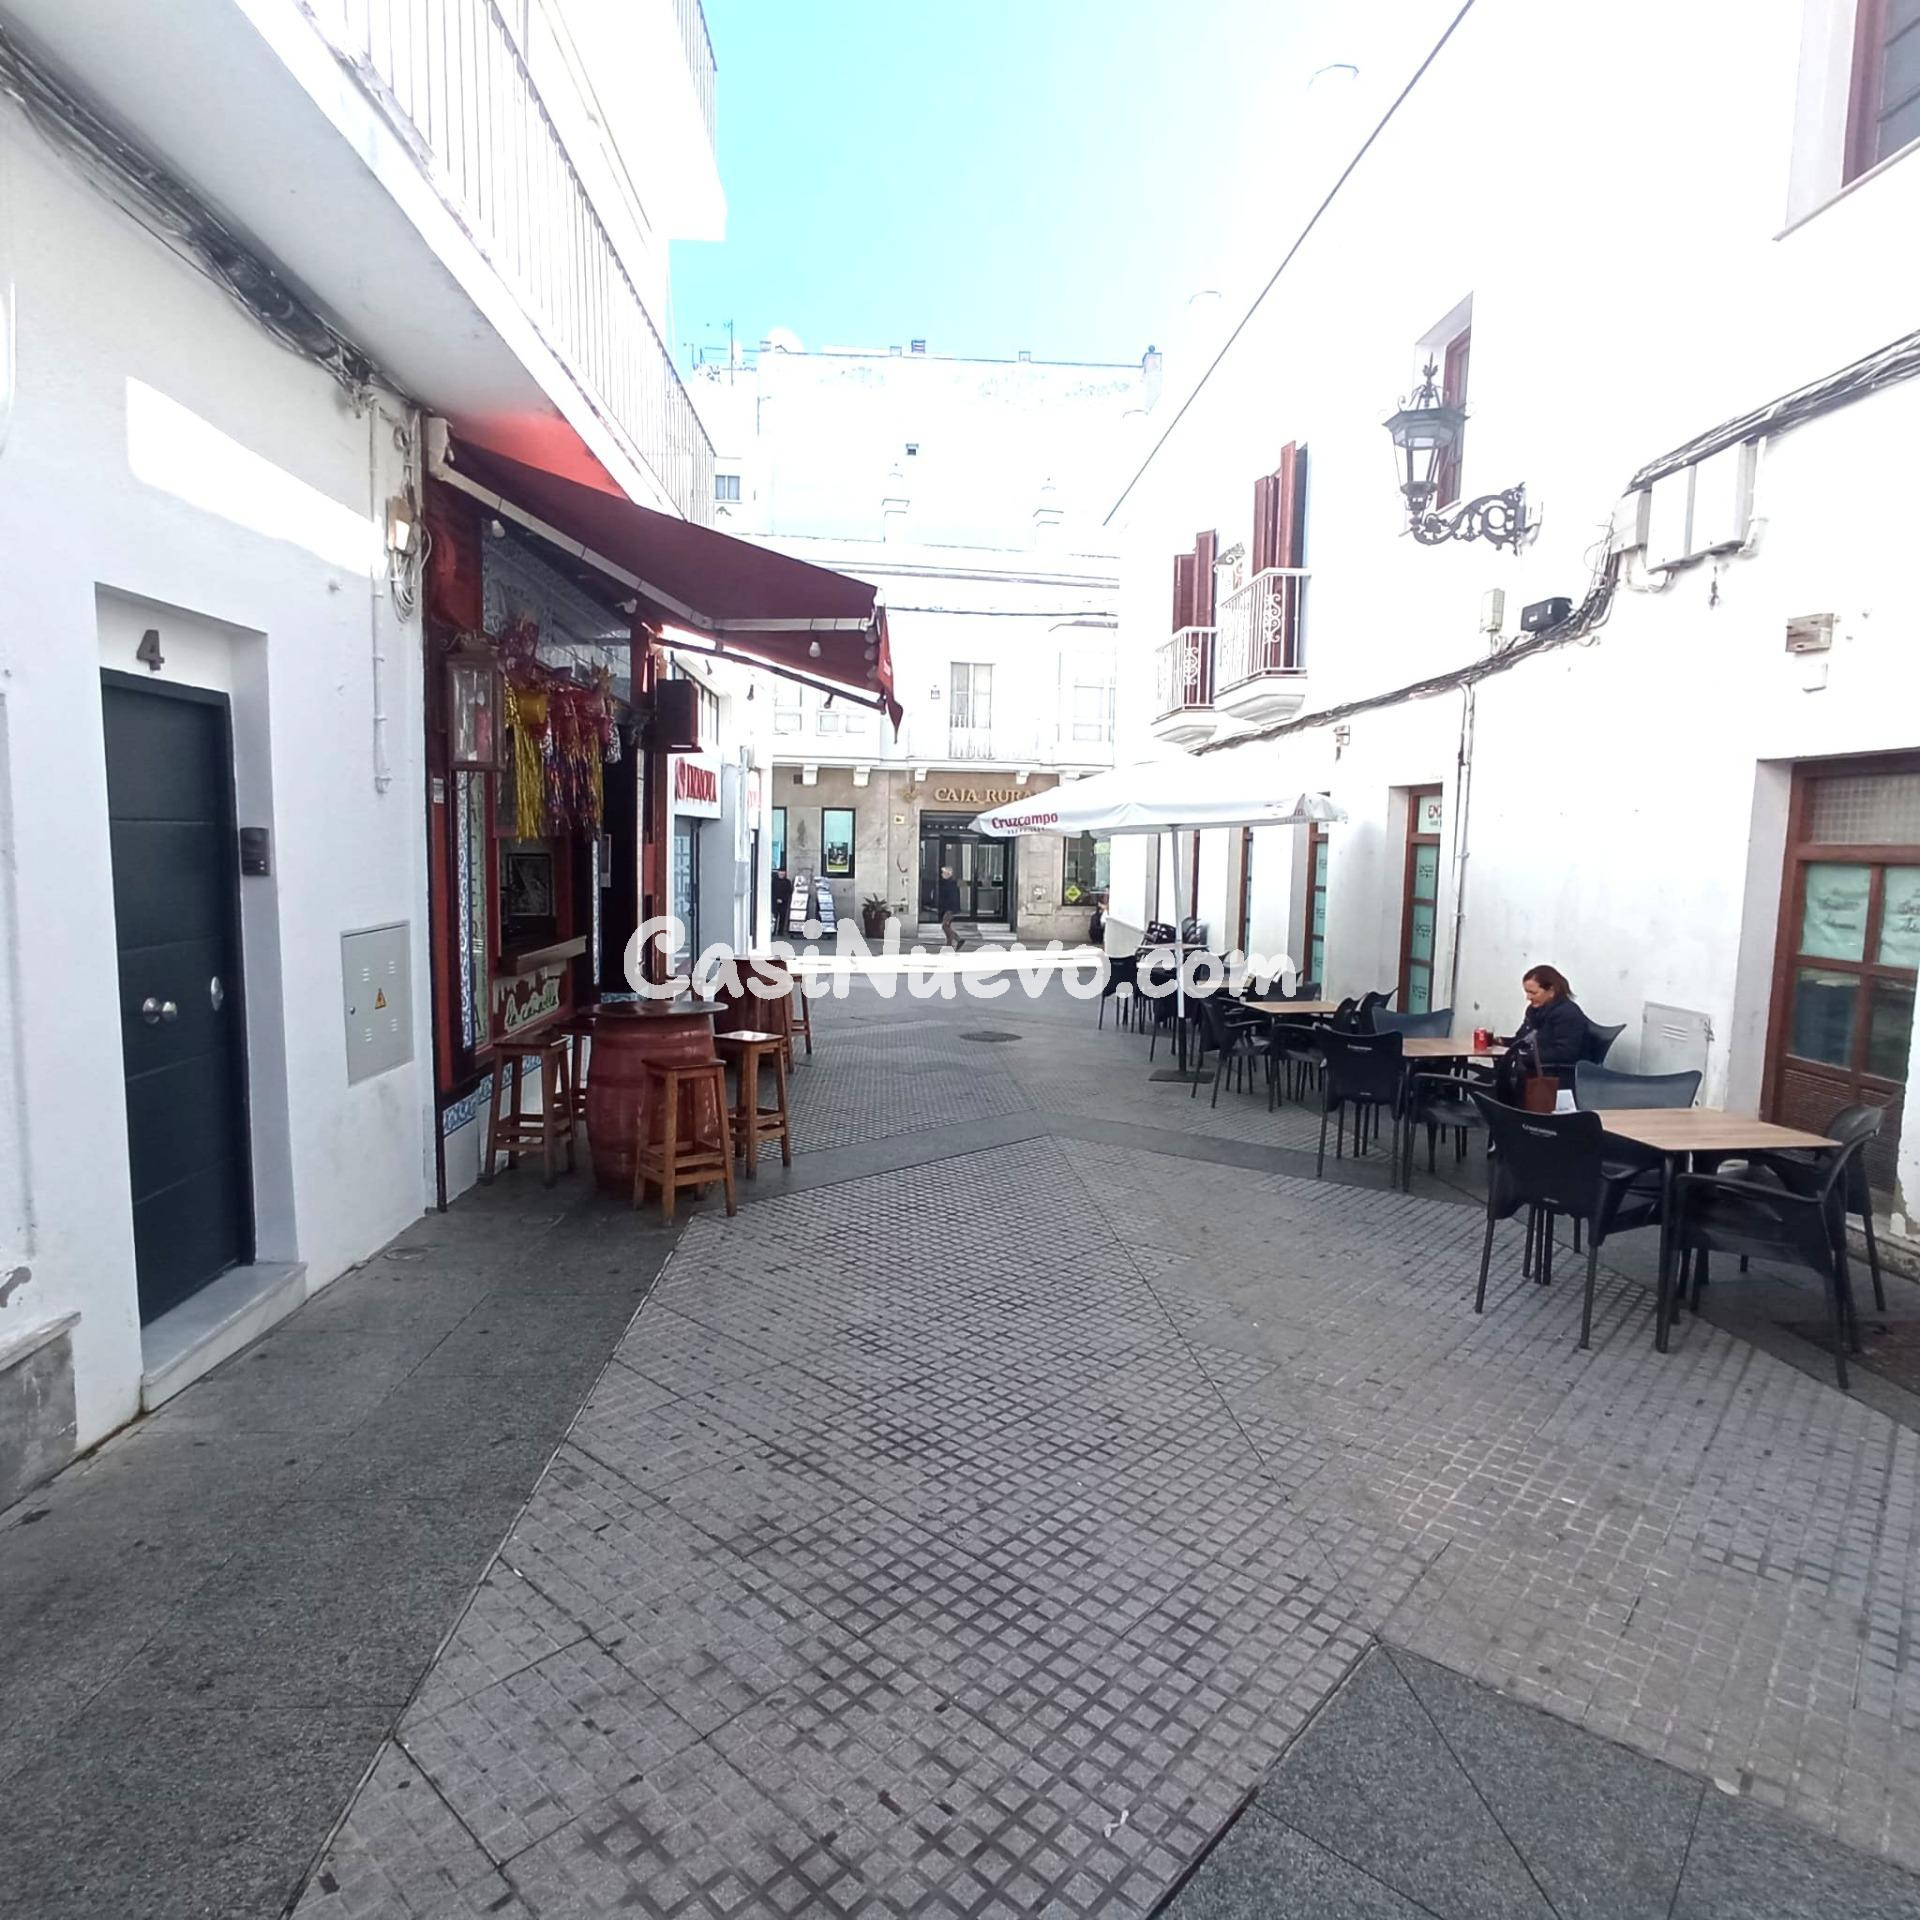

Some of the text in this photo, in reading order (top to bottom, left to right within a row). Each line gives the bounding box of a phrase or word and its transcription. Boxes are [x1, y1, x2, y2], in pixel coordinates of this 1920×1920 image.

[136, 629, 165, 671] 4
[934, 787, 978, 804] CAJA
[991, 812, 1058, 829] Cruzcampo
